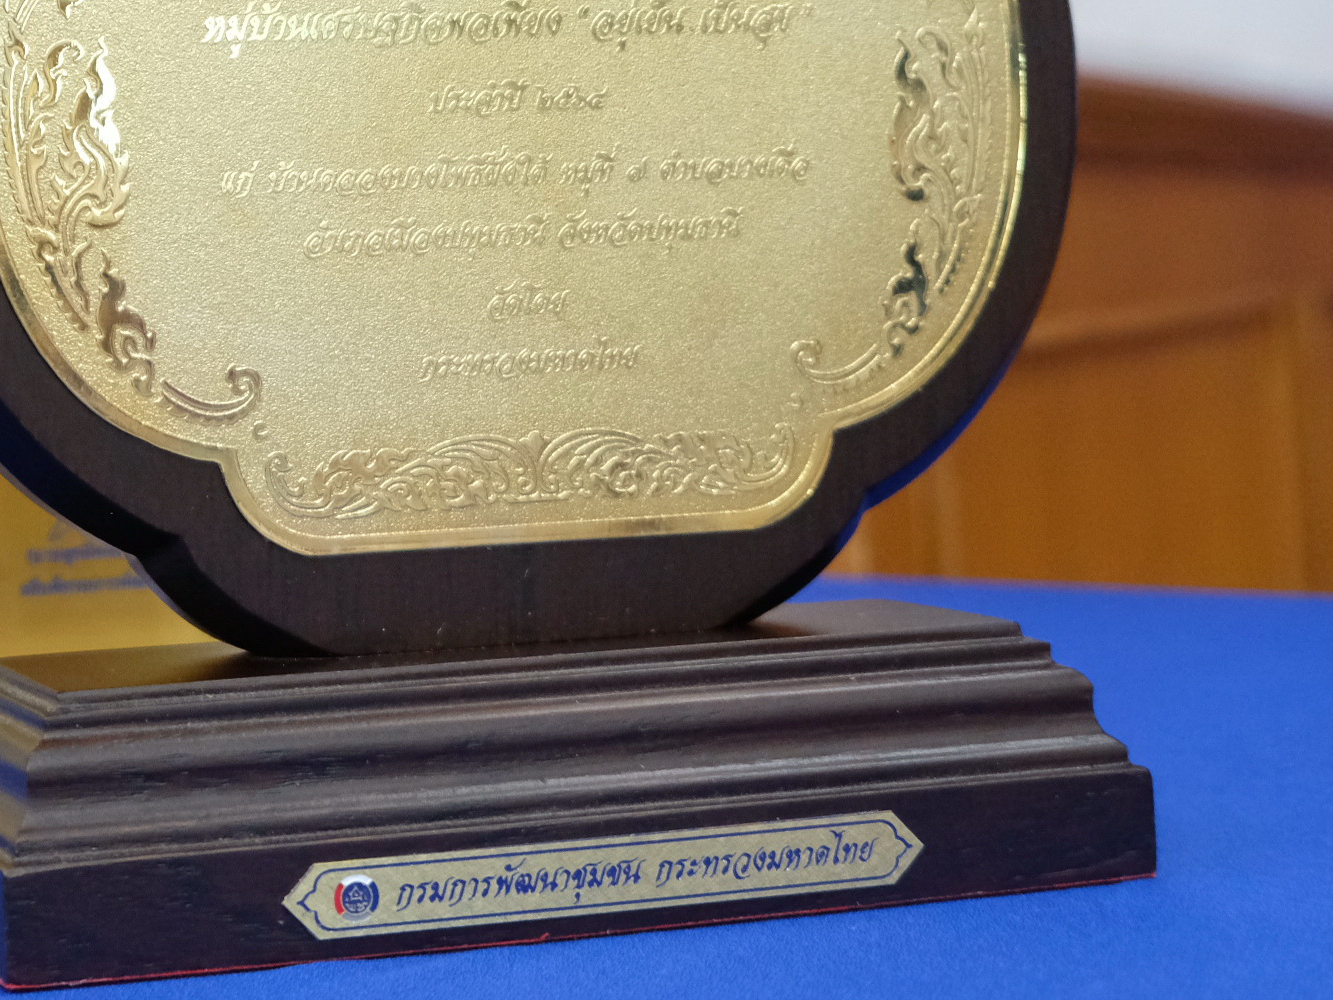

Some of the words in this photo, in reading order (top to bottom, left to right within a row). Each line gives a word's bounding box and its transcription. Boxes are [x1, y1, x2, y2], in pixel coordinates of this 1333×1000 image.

[427, 79, 529, 116] ประจำปี
[220, 160, 260, 198] แก่
[659, 140, 810, 186] ตำบลบางเดื่อ
[303, 214, 549, 262] อำเภอเมืองปทุมธานี
[557, 206, 745, 254] จังหวัดปทุมธานี
[487, 280, 571, 322] จัดโดย
[418, 334, 643, 383] กระทรวงมหาดไทย
[396, 858, 642, 909] กรมการพัฒนาชุมชน
[655, 829, 875, 885] กระทรวงมหาดไทย
